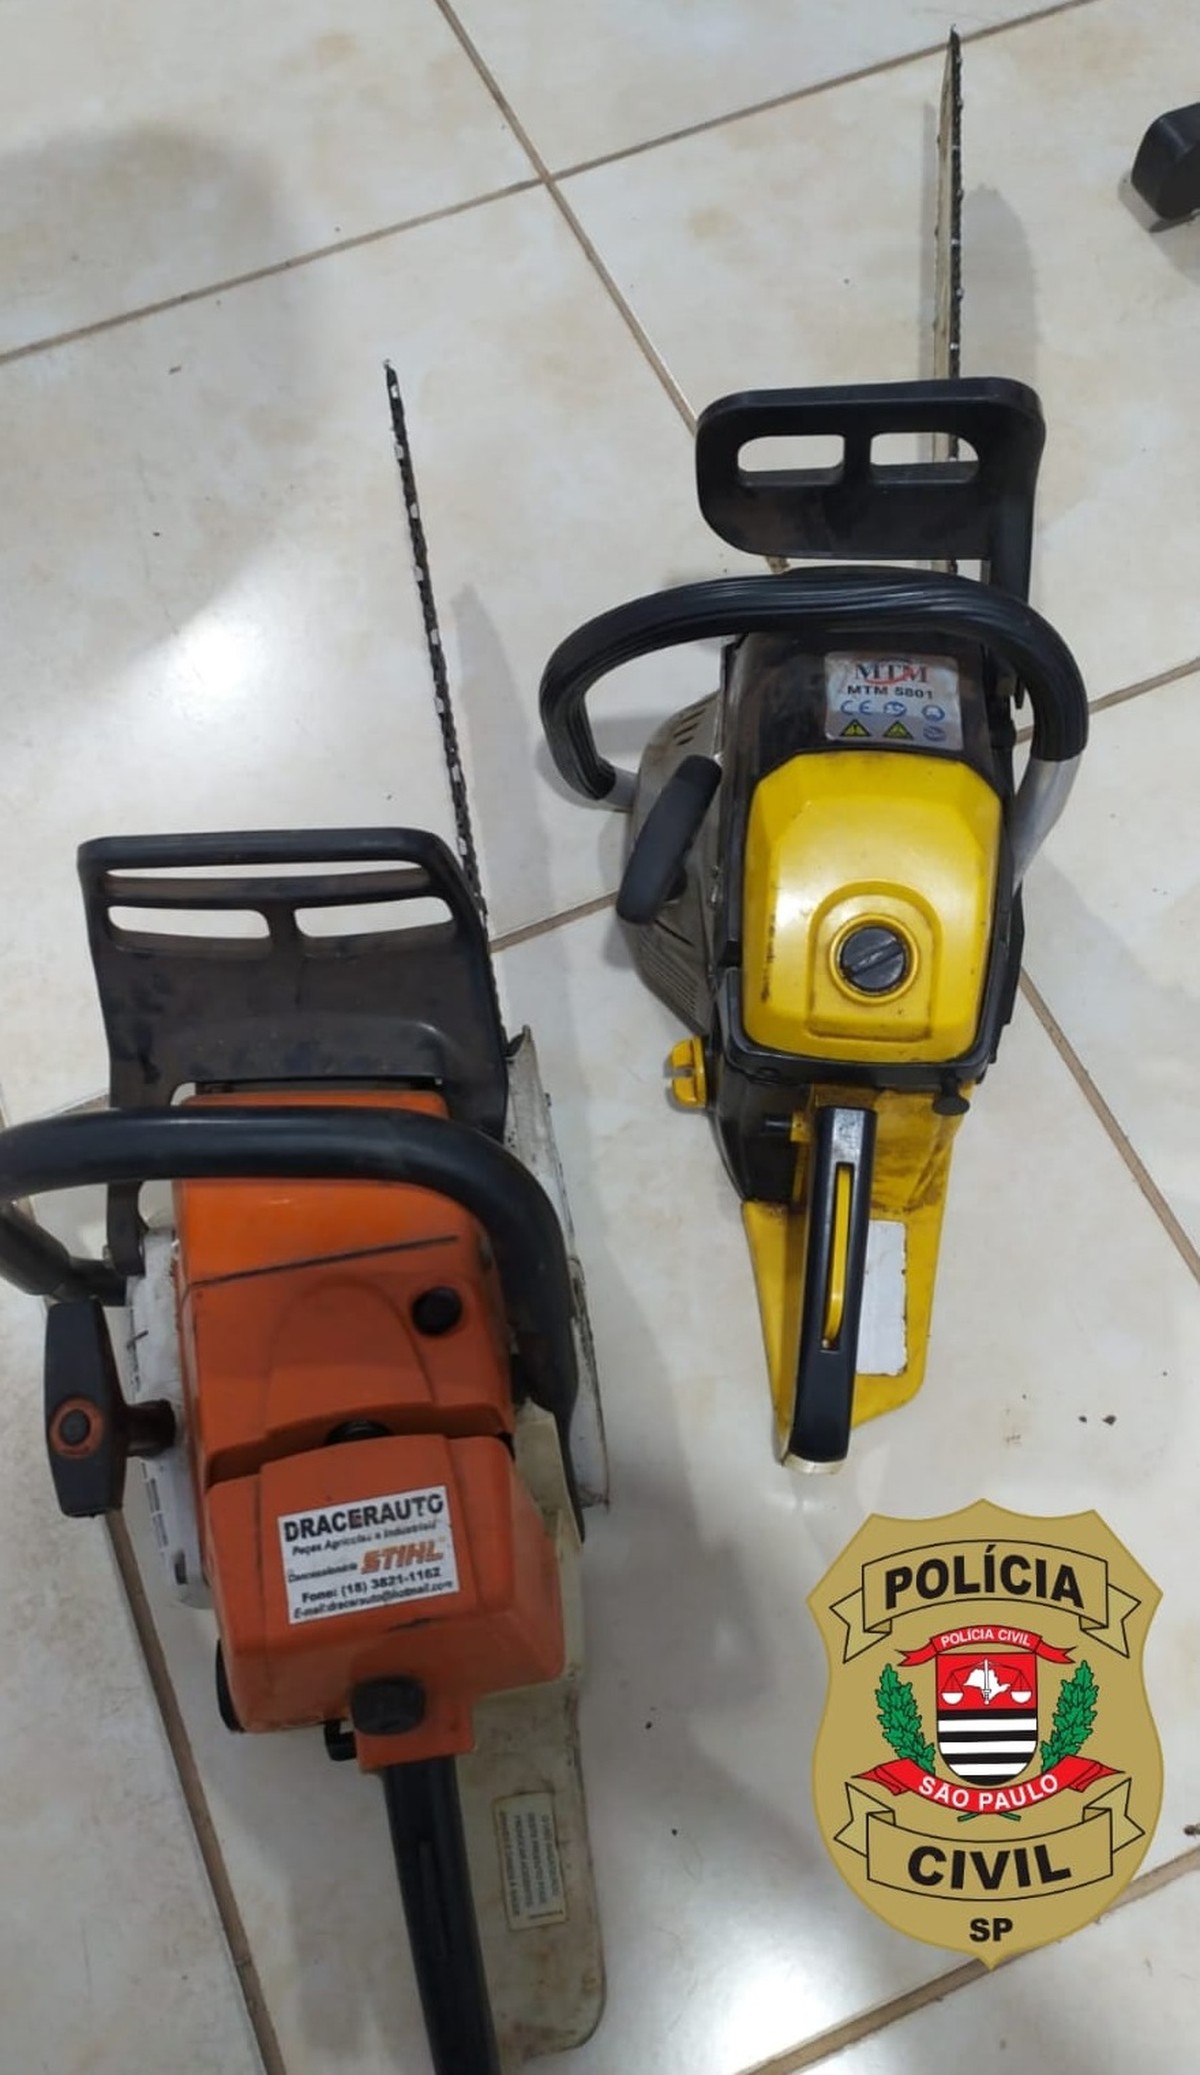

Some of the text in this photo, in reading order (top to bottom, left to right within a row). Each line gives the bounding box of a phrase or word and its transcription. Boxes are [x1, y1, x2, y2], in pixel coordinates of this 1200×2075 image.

[855, 664, 928, 683] MTM
[847, 685, 933, 699] MTM 5801
[284, 1494, 444, 1542] DRACERAUTO
[360, 1541, 444, 1575] STIHL
[302, 1589, 338, 1603] Fone:
